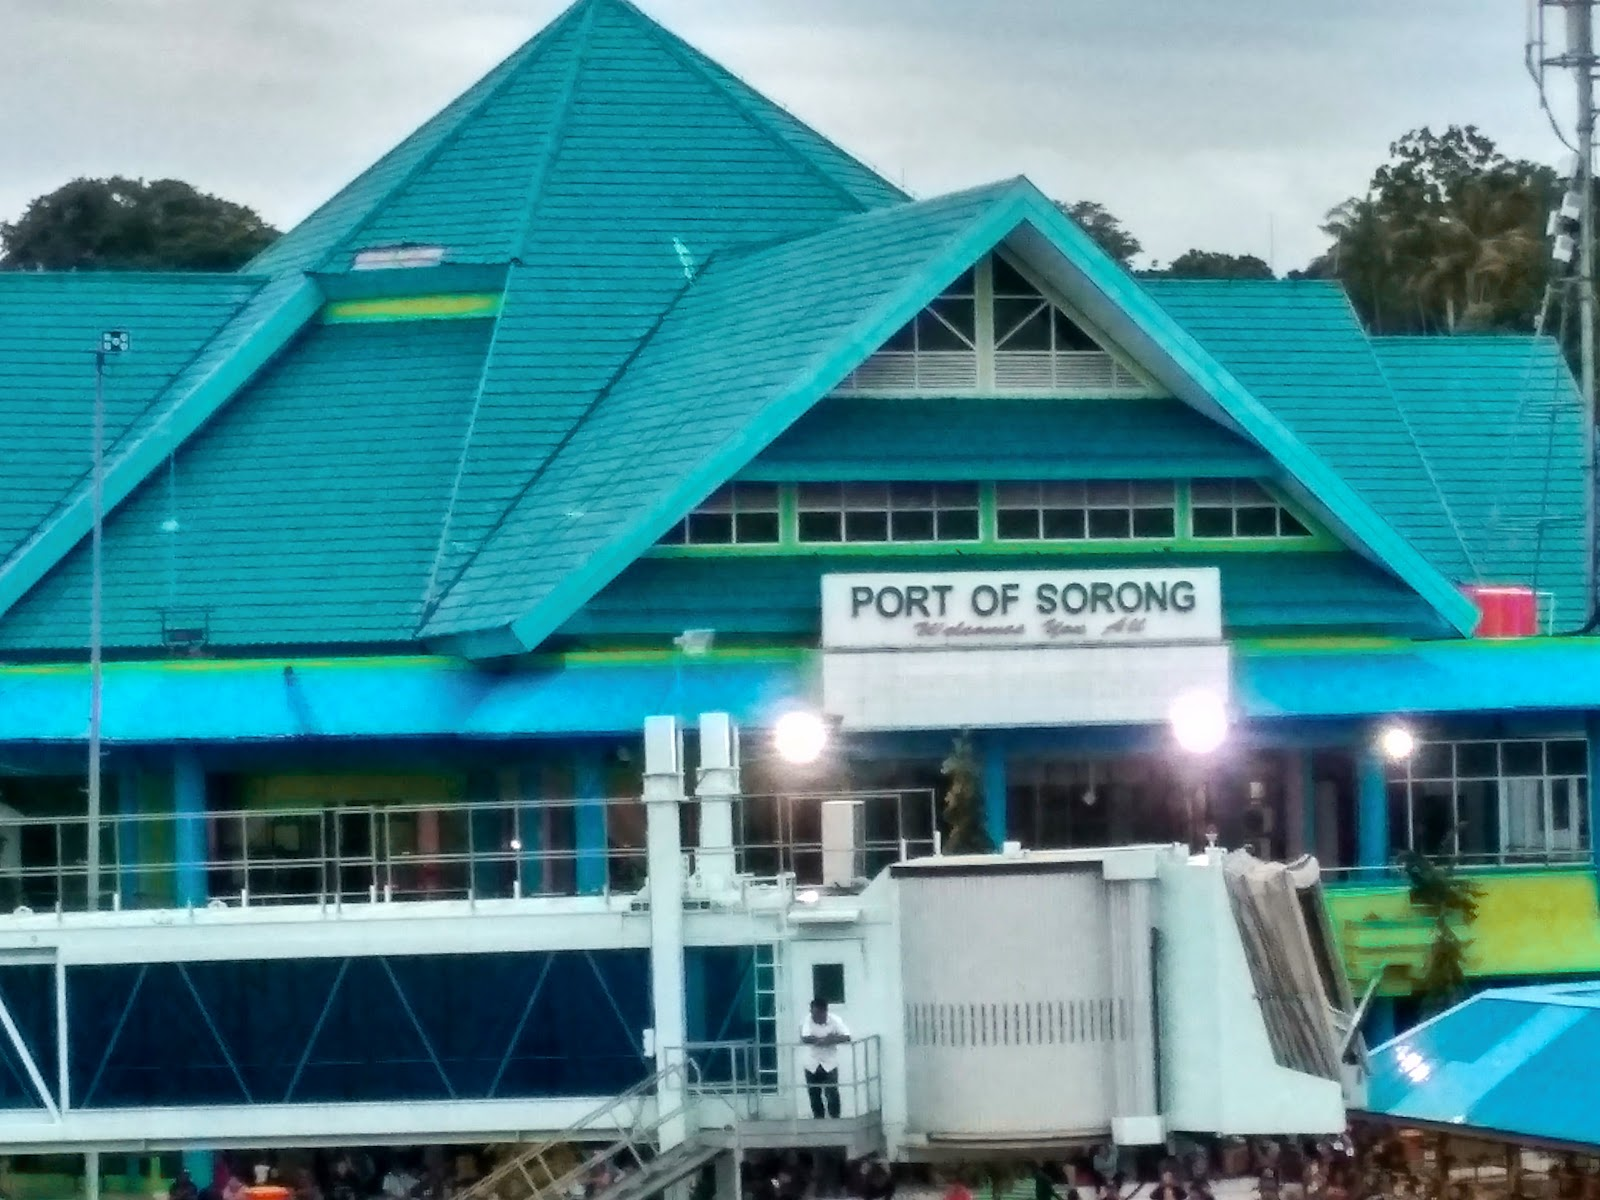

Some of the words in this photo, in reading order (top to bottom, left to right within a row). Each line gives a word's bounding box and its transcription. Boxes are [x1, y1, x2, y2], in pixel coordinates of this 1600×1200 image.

[851, 585, 953, 618] PORT
[971, 584, 1020, 616] OF
[1036, 581, 1196, 614] SORONG
